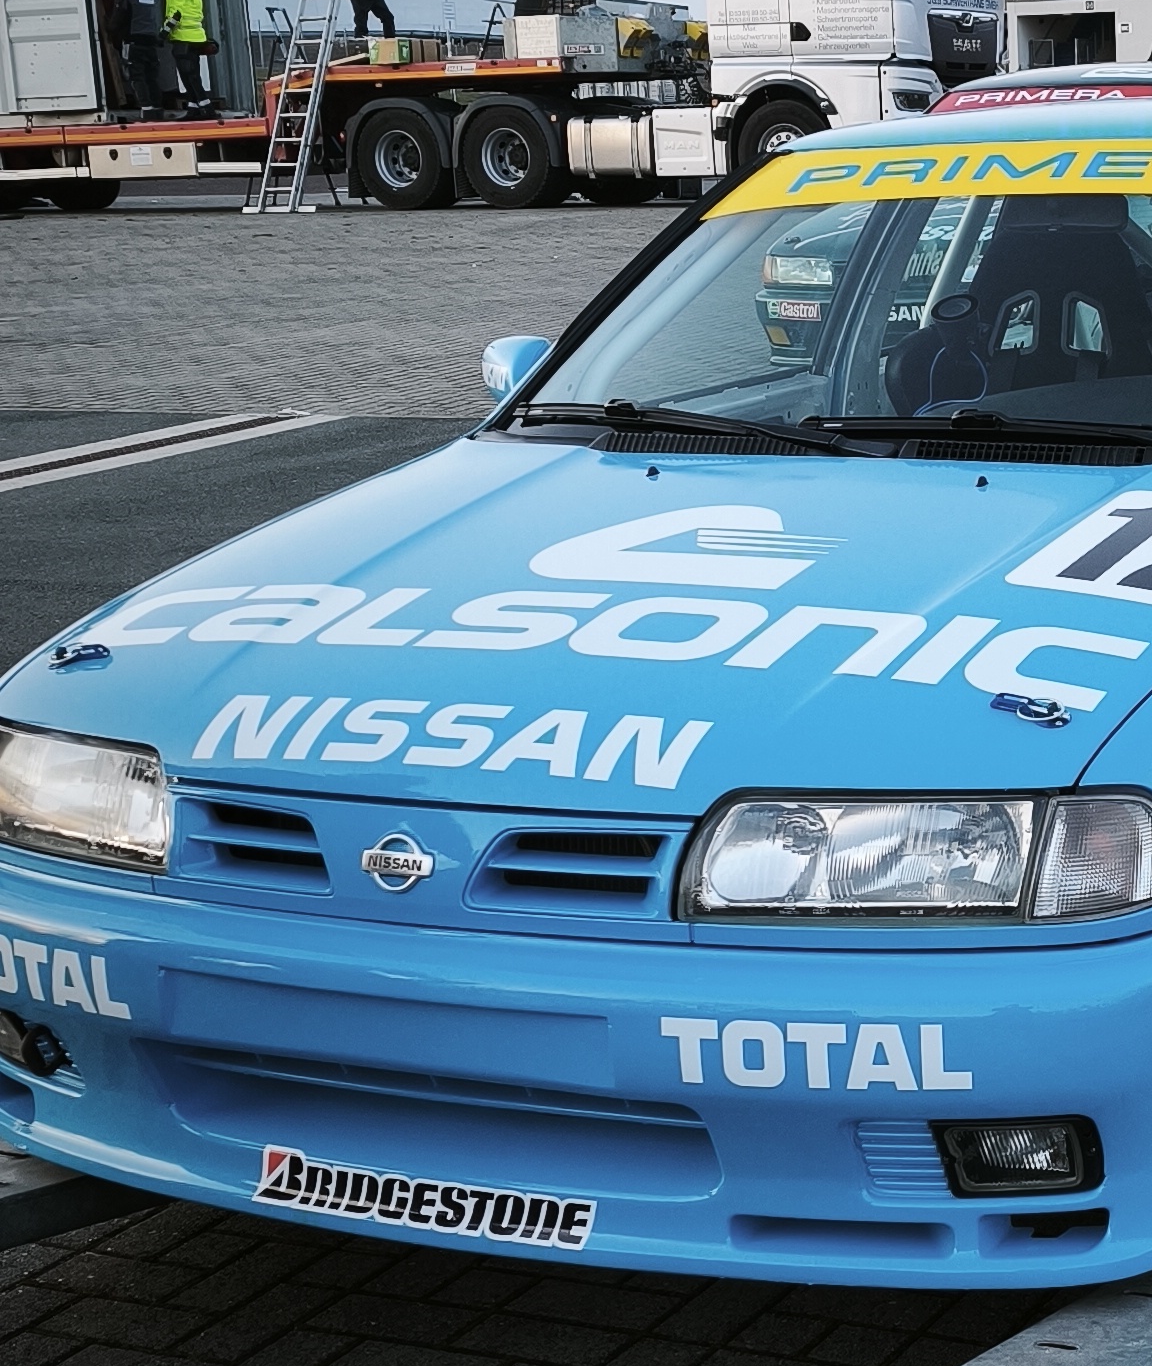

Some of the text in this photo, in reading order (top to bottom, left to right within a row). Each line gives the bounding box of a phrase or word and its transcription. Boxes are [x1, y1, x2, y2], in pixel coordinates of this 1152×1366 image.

[954, 88, 1126, 107] PRIMERA
[664, 140, 701, 150] MAN
[780, 301, 818, 318] Castrol
[192, 695, 714, 790] NISSAN
[367, 855, 423, 872] NISSAN
[660, 1016, 973, 1091] TOTAL
[254, 1151, 594, 1246] BRIDGESTONE
